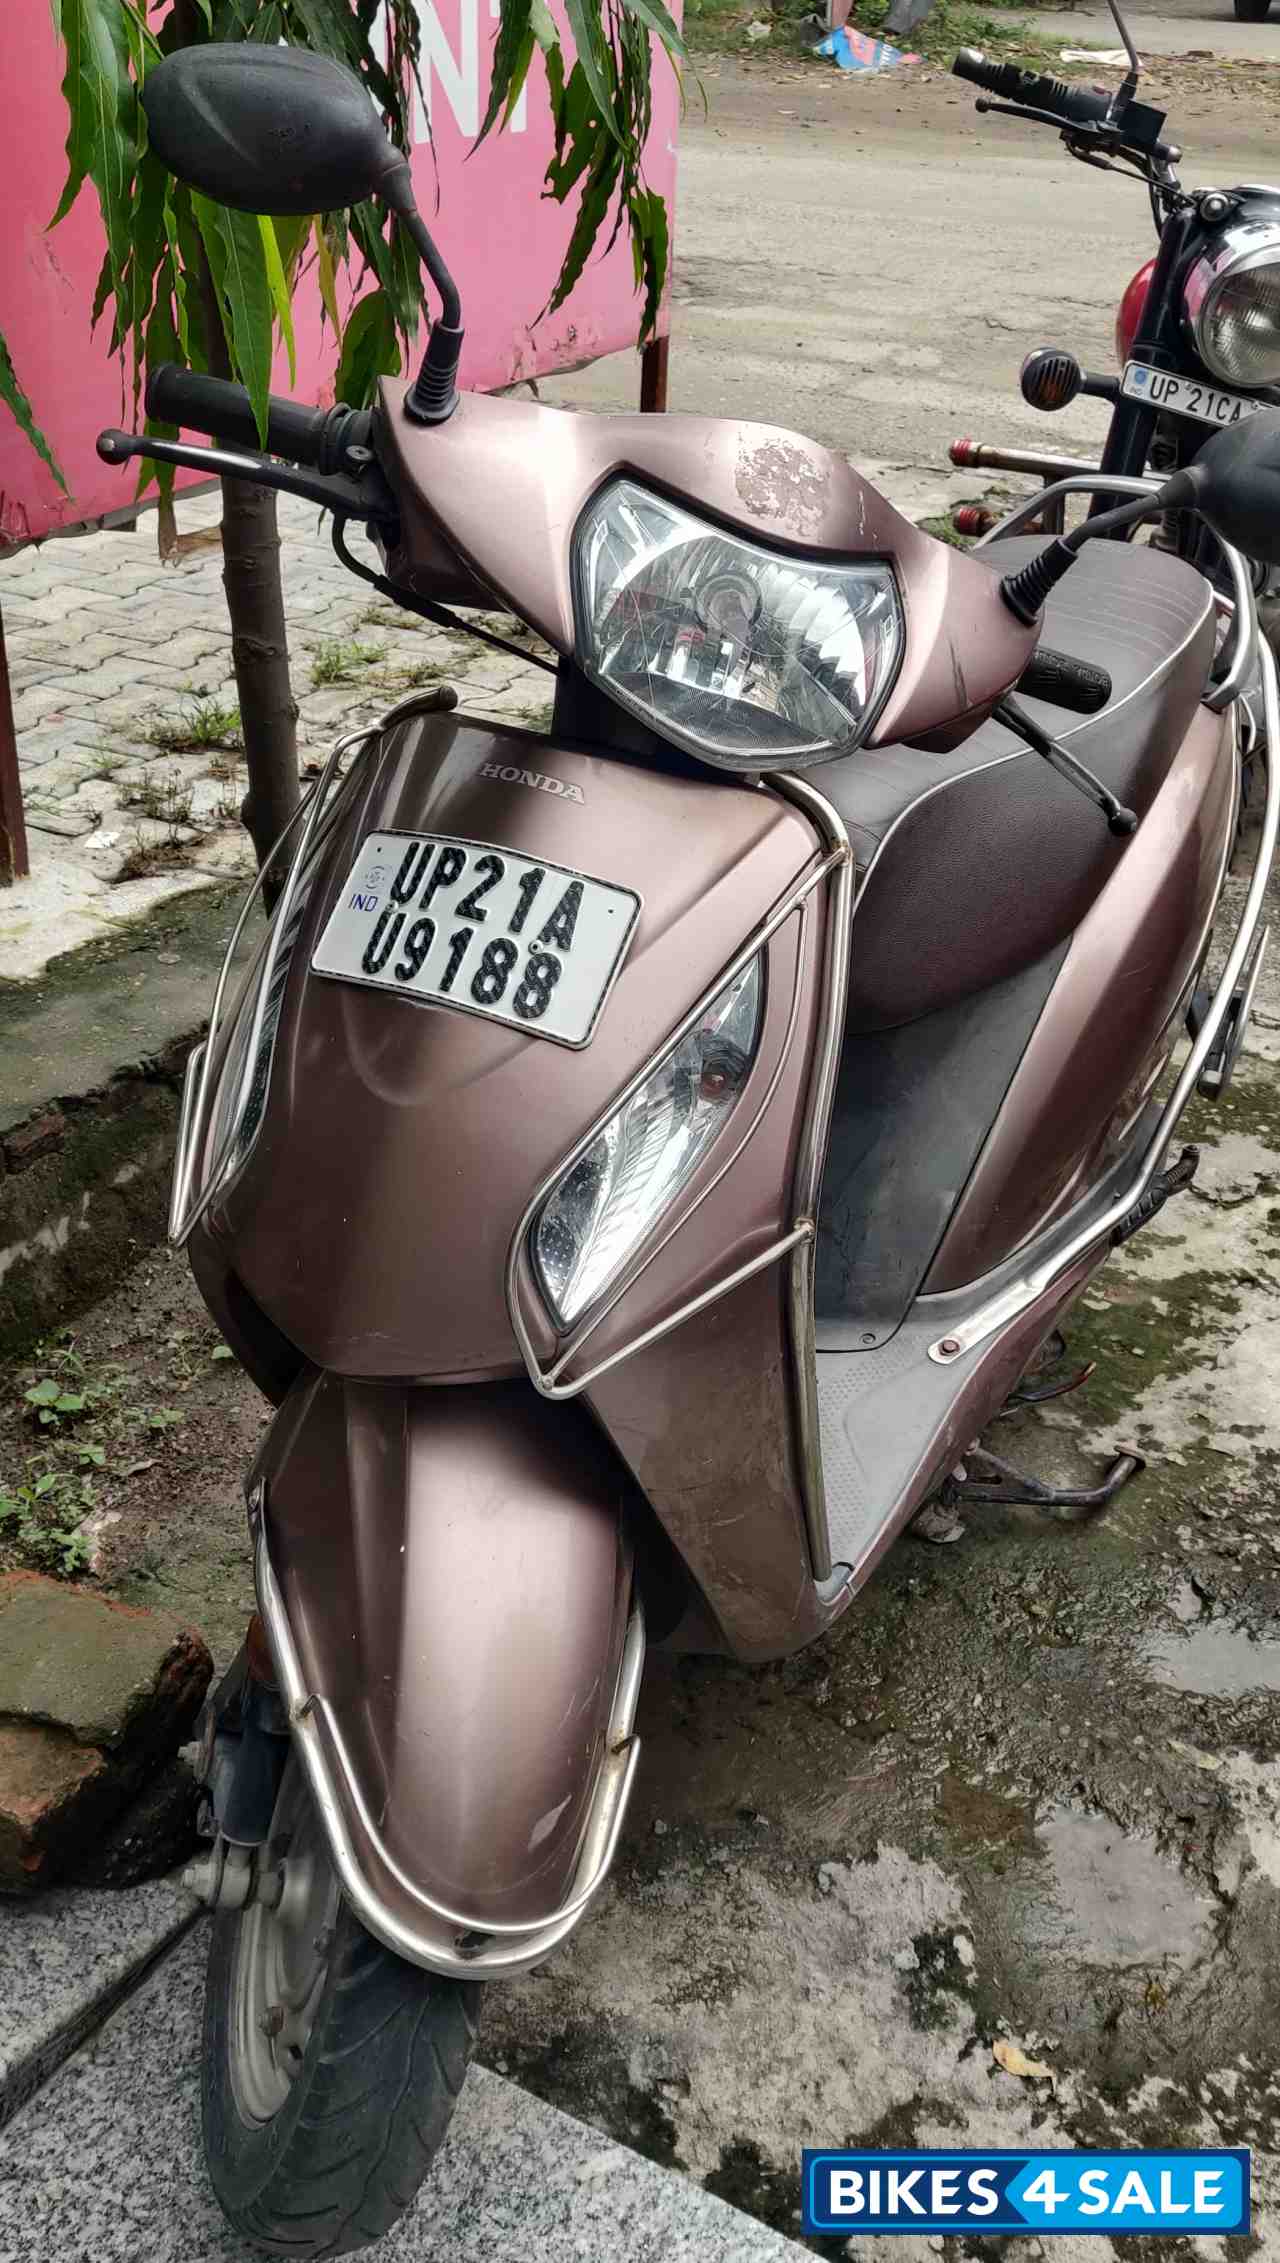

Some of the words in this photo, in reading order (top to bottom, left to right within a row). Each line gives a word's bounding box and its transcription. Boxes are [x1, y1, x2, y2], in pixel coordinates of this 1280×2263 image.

[480, 763, 585, 804] HONDA
[348, 894, 378, 912] IND
[390, 841, 584, 952] UP21A
[361, 909, 562, 1019] U9188
